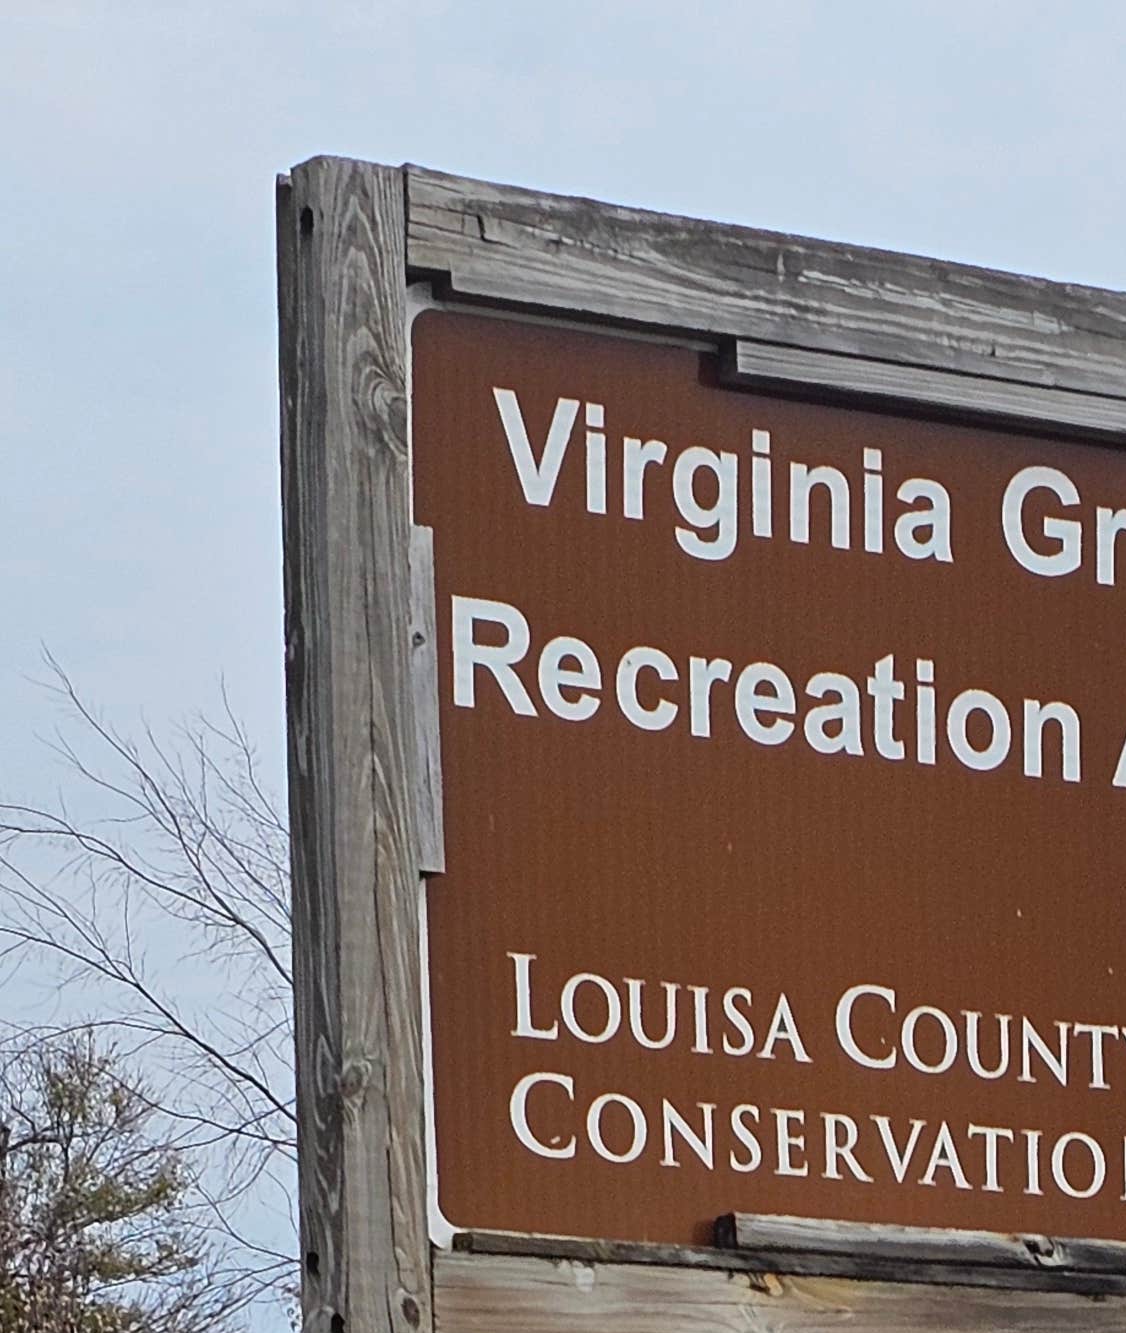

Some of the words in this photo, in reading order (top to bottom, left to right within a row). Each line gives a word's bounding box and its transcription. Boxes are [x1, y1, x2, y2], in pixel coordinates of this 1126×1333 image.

[493, 387, 953, 562] Virginia
[452, 595, 1080, 782] Recreation
[508, 953, 812, 1062] LOUISA
